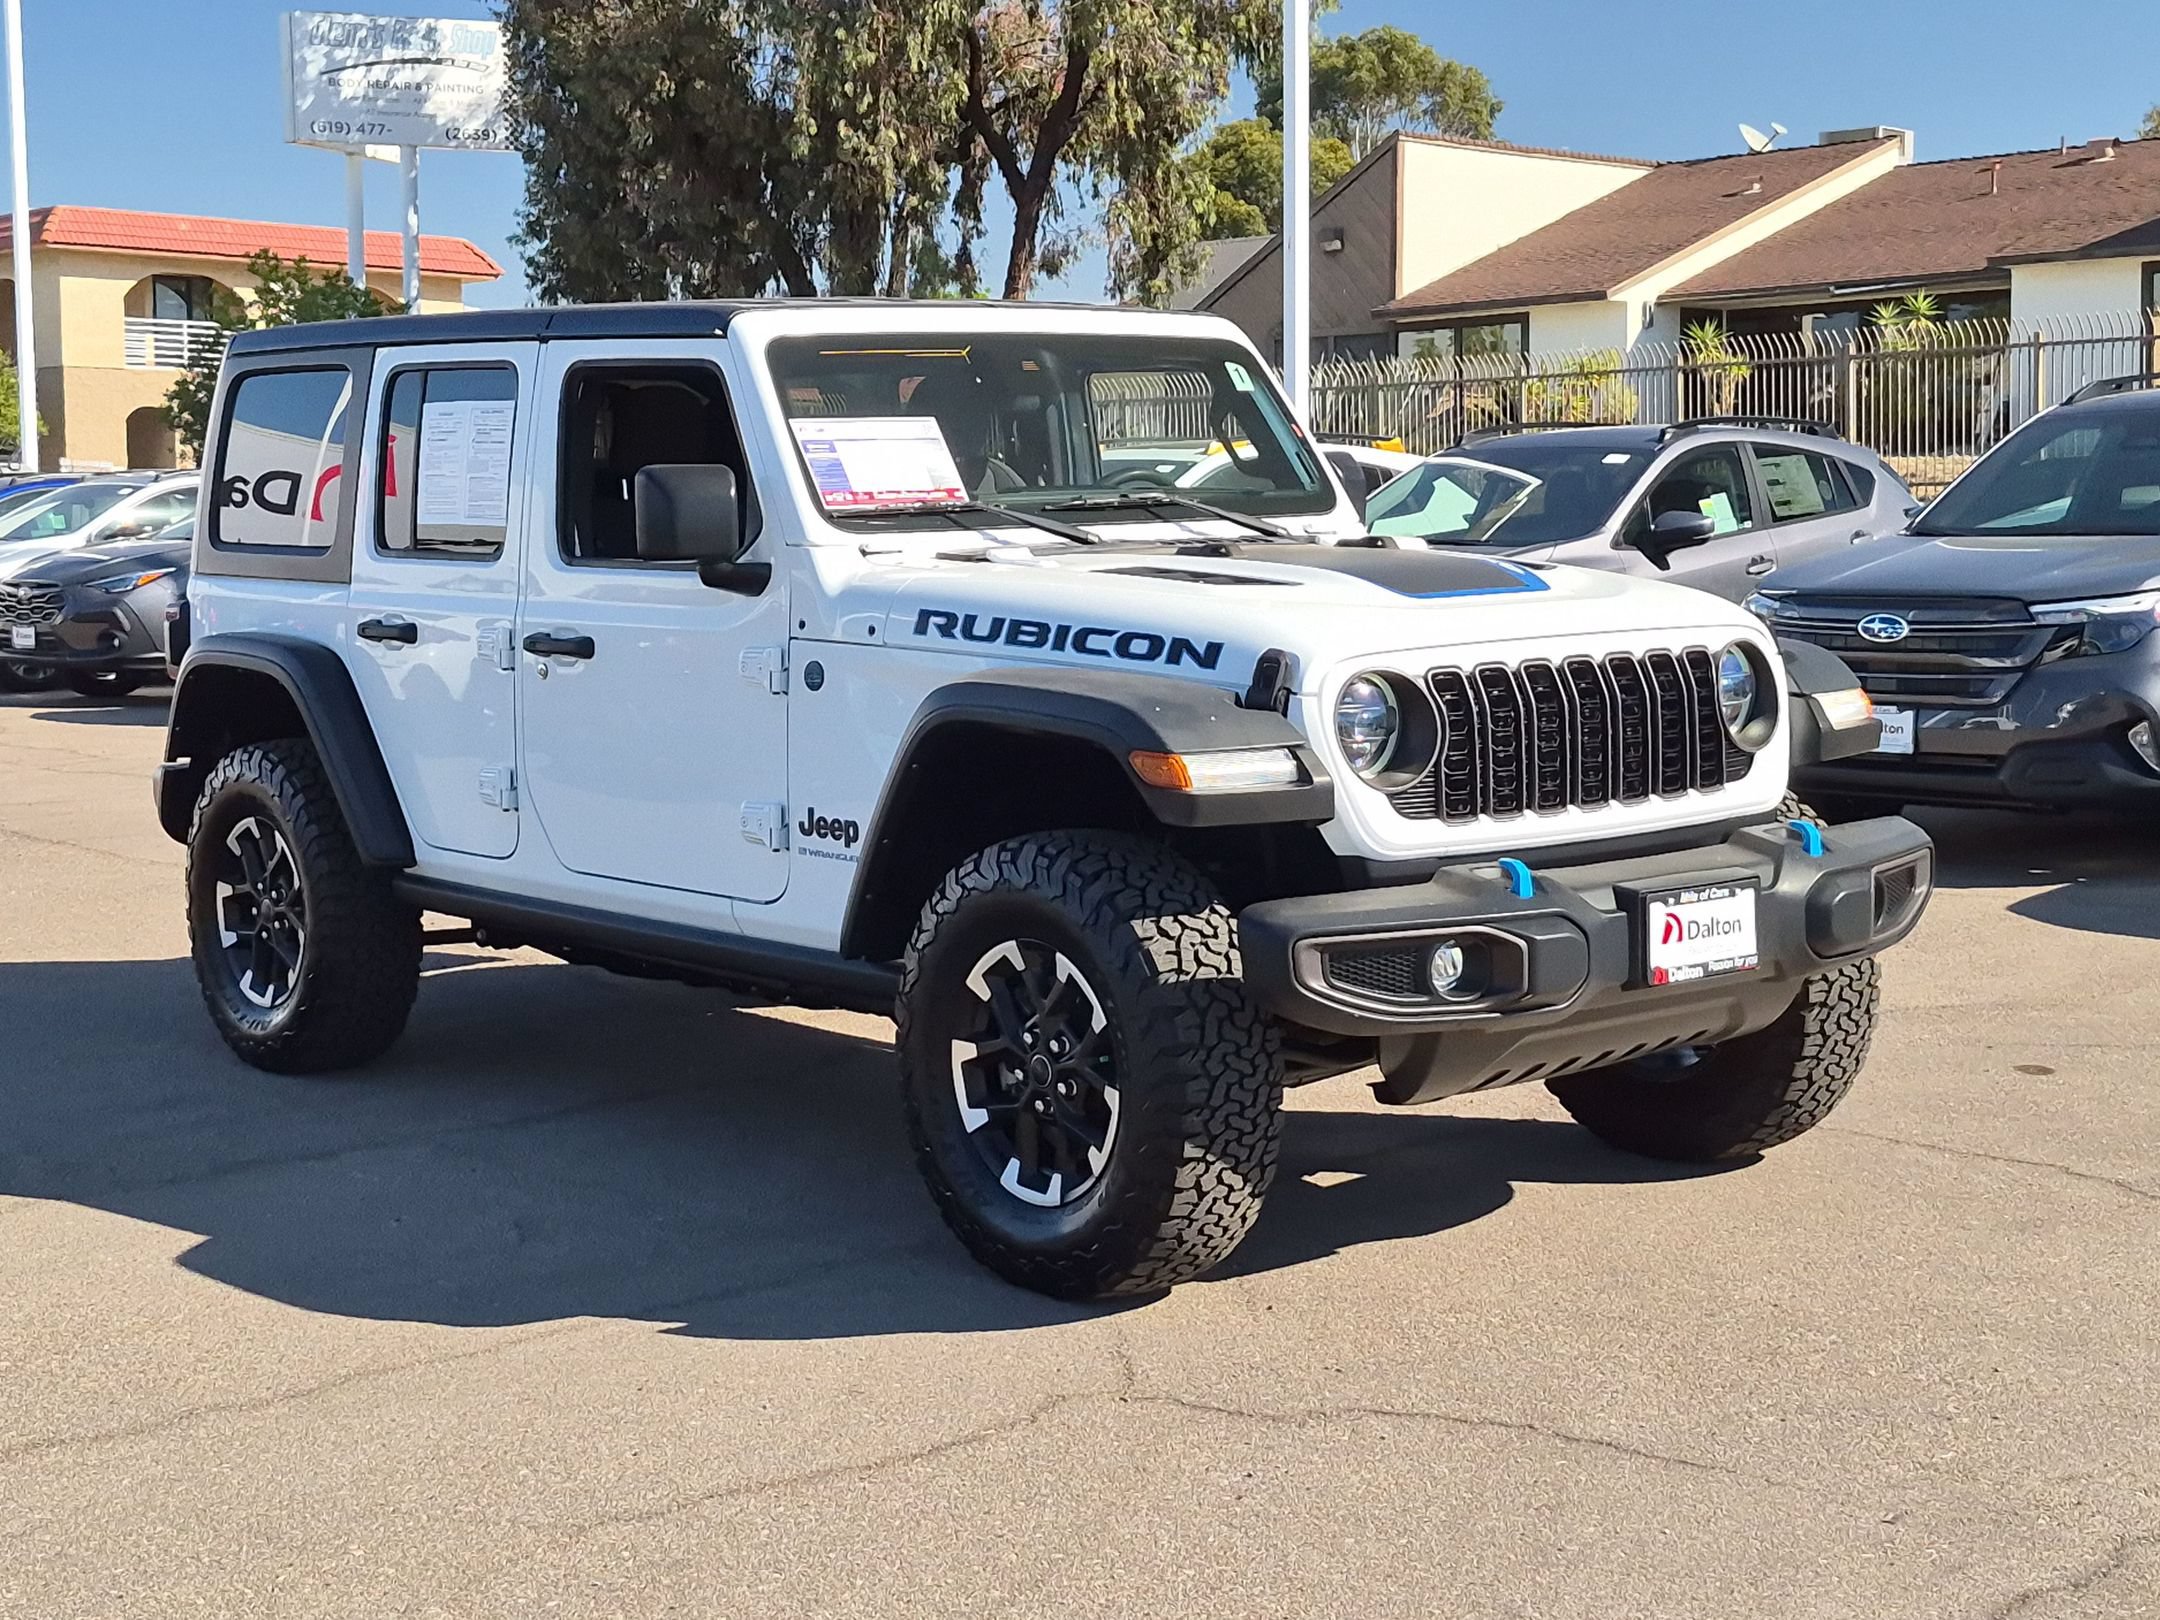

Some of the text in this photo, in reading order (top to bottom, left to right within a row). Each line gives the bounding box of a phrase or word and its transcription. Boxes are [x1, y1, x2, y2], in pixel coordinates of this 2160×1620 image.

[448, 23, 497, 60] Shop
[327, 77, 361, 88] BODY
[367, 79, 412, 91] REPAIR
[426, 83, 484, 95] PAINTING
[310, 120, 393, 136] (619) 477-
[912, 608, 1225, 670] RUBICON
[798, 806, 859, 849] Jeep
[1687, 916, 1741, 940] Dalton
